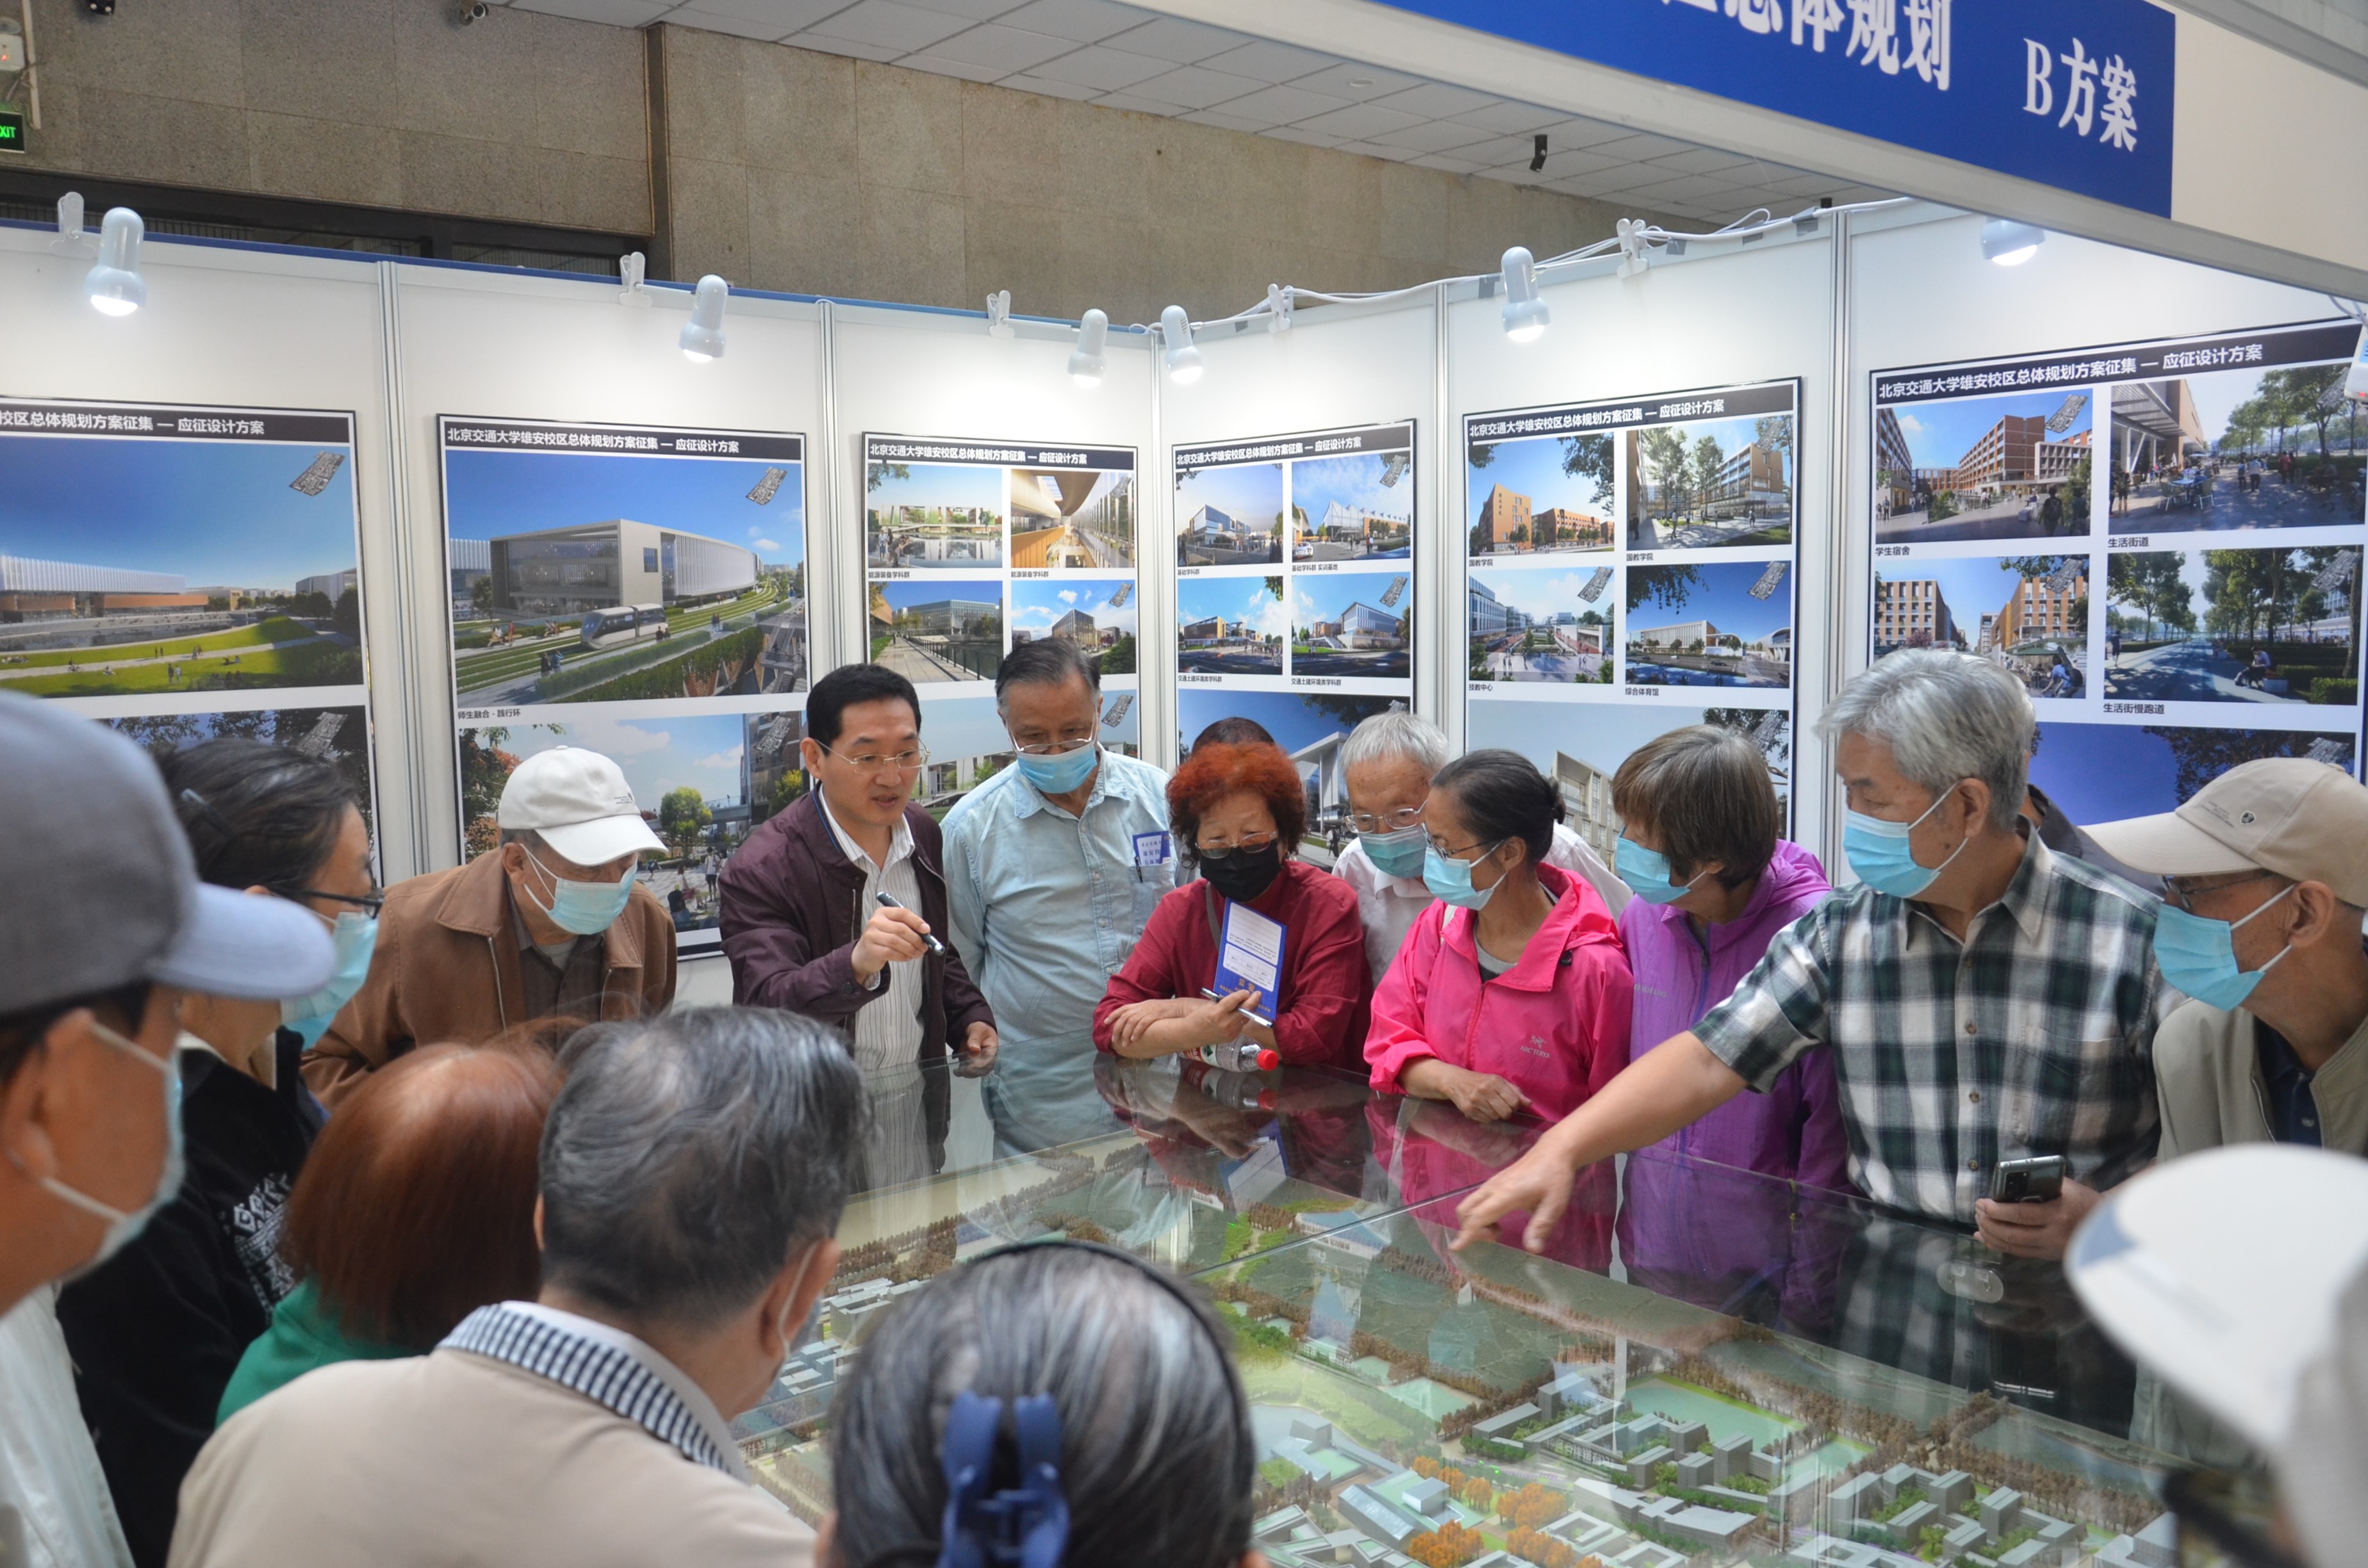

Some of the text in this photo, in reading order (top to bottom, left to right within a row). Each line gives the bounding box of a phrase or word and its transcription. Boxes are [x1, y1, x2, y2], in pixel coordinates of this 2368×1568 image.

[2023, 37, 2137, 152] B方案
[1879, 357, 2137, 398] 北京交通大学雄安校区总体规划方案征集
[2163, 344, 2263, 370] 应征设计方案
[178, 418, 265, 434] 应征设计方案
[1469, 408, 1643, 437] 北京交通大学雄安校区总体规划方案征集
[1659, 398, 1725, 418] 应征设计方案
[447, 428, 659, 450] 北京交通大学雄安校区总体规划方案征集
[676, 439, 739, 453] 应征设计方案
[1176, 443, 1303, 465] 北京交通大学雄安校区总体规划方案征集
[1315, 436, 1361, 452] 应征设计方案
[869, 443, 1026, 462] 北京交通大学雄安校区总体规划方案征集
[1039, 453, 1087, 466] 应征设计方案
[1875, 545, 1911, 556] 学生宿舍
[2107, 536, 2149, 548] 生活街道
[457, 709, 490, 719] 师生融合
[2103, 703, 2165, 714] 生活街慢跑道
